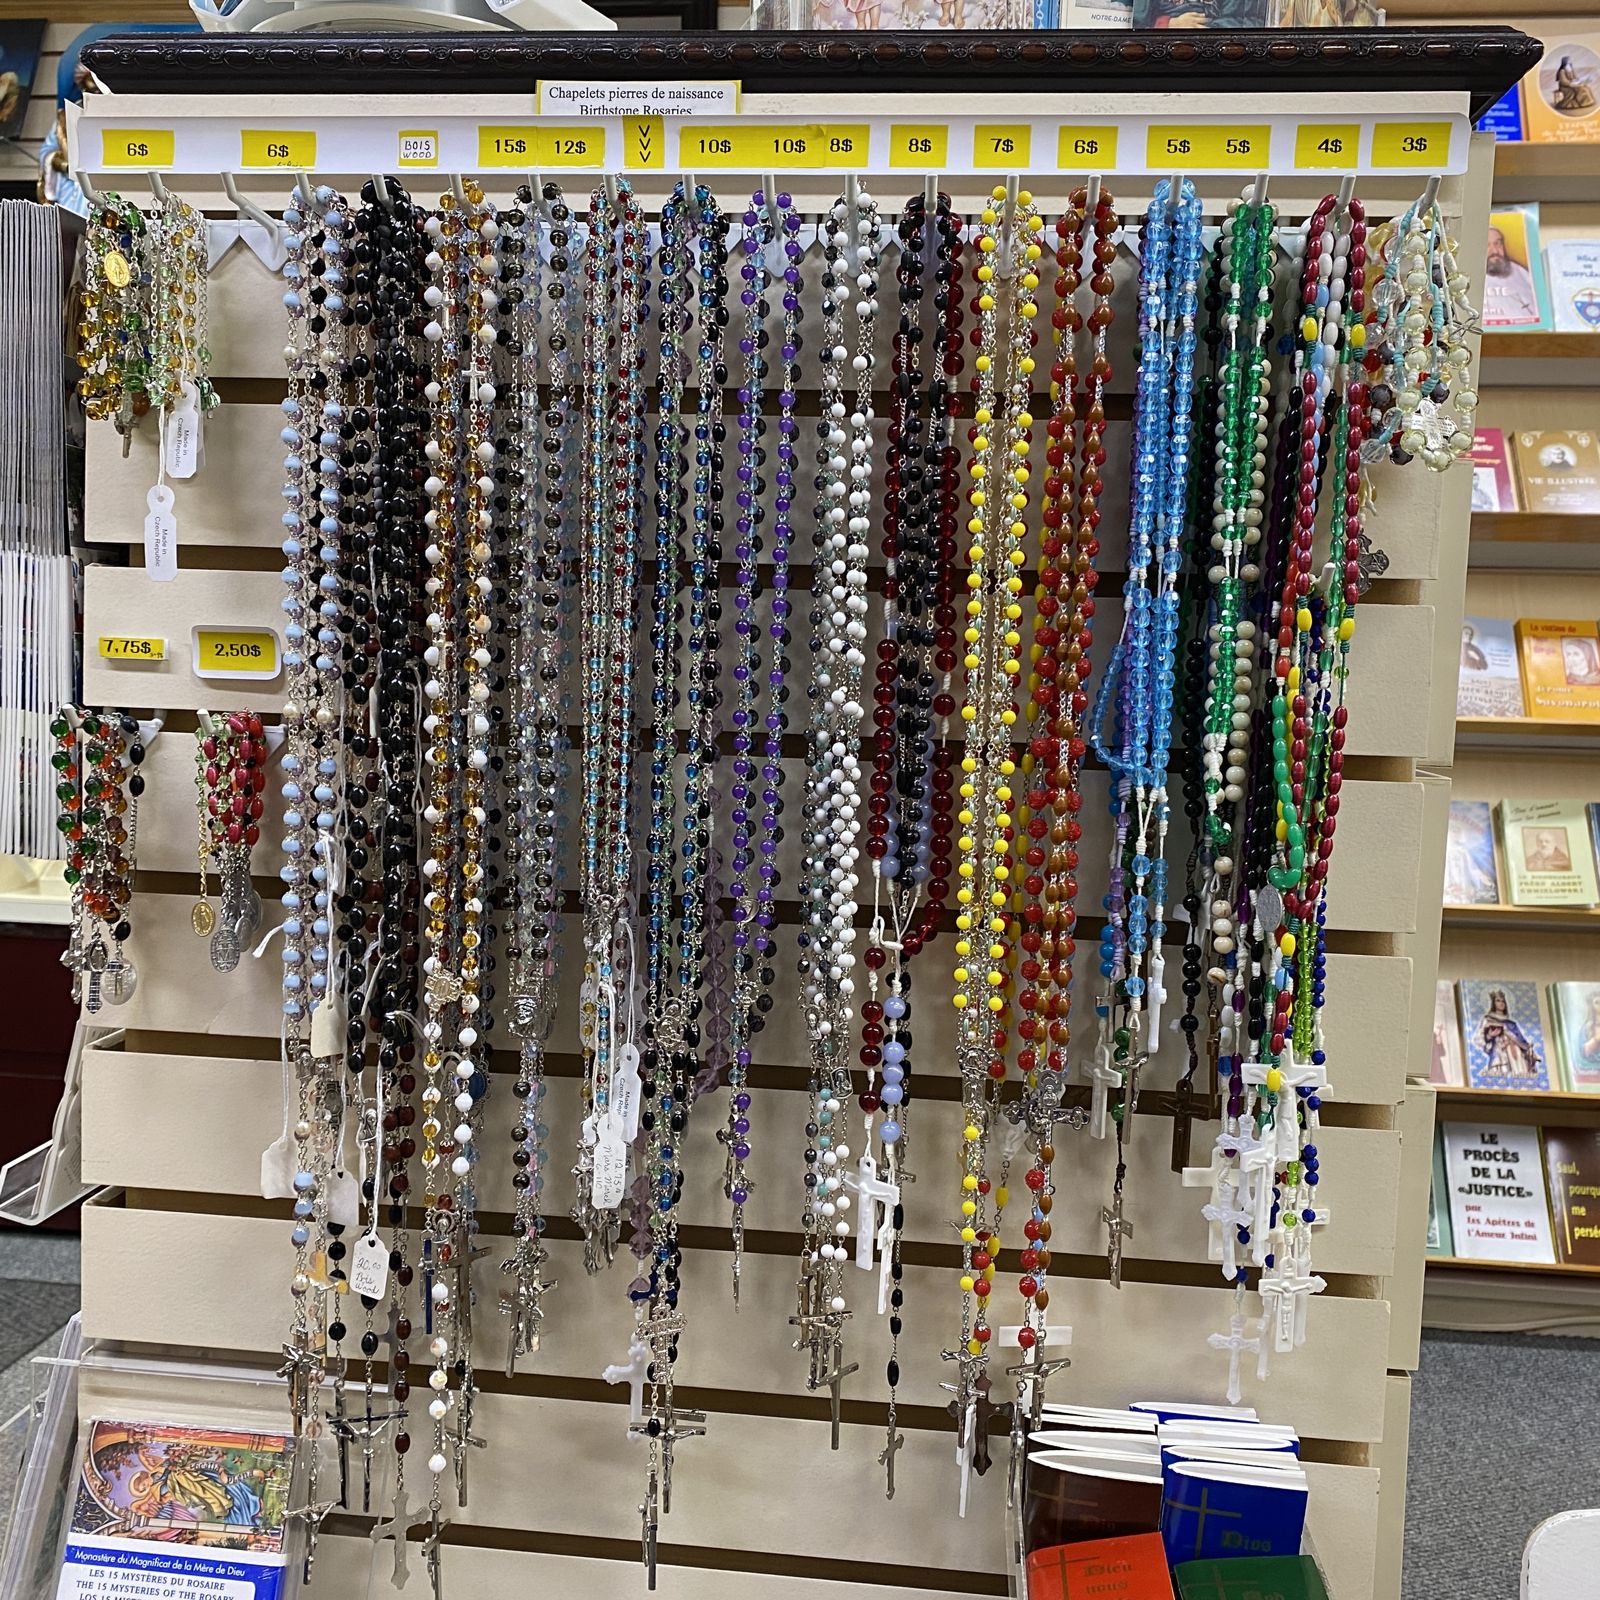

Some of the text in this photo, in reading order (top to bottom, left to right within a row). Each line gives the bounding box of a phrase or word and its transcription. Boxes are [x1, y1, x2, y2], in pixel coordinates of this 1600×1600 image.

[549, 87, 723, 101] Chapelets pierres de naissance
[580, 104, 692, 114] Birthstone Rosaries
[127, 142, 149, 157] 6$
[267, 143, 289, 158] 6$
[405, 140, 431, 151] BOIS
[495, 139, 526, 154] 15$
[554, 140, 586, 155] 12$
[699, 139, 732, 154] 10$
[773, 138, 806, 154] 10$
[829, 138, 853, 153] 8$
[908, 138, 932, 153] 8$
[990, 138, 1014, 154] 7$
[1074, 139, 1098, 155] 6$
[1166, 139, 1191, 154] 5$
[1226, 139, 1250, 154] 5$
[1317, 138, 1343, 154] 4$
[1402, 137, 1428, 152] 3$
[403, 151, 432, 159] WOOD
[176, 417, 184, 439] Czech
[153, 538, 161, 567] Republic
[103, 639, 151, 655] 7,75$
[214, 643, 262, 658] 2,50$
[623, 1110, 628, 1118] in
[1480, 1132, 1498, 1145] LE
[1463, 1147, 1520, 1163] PROCÈS
[1471, 1166, 1516, 1180] DE LA
[1556, 1161, 1580, 1176] Saul,
[1457, 1183, 1533, 1198] «JUSTICE»
[1571, 1205, 1587, 1216] me
[74, 1548, 246, 1577] Monastère du Magnificat de la Mère de Dieu
[89, 1568, 226, 1591] LES 15 MYSTÈRES DU ROSAIRE
[76, 1580, 94, 1590] THE
[97, 1582, 107, 1591] 15
[110, 1583, 160, 1596] MYSTERIES
[163, 1589, 176, 1598] OF
[179, 1590, 197, 1600] THE
